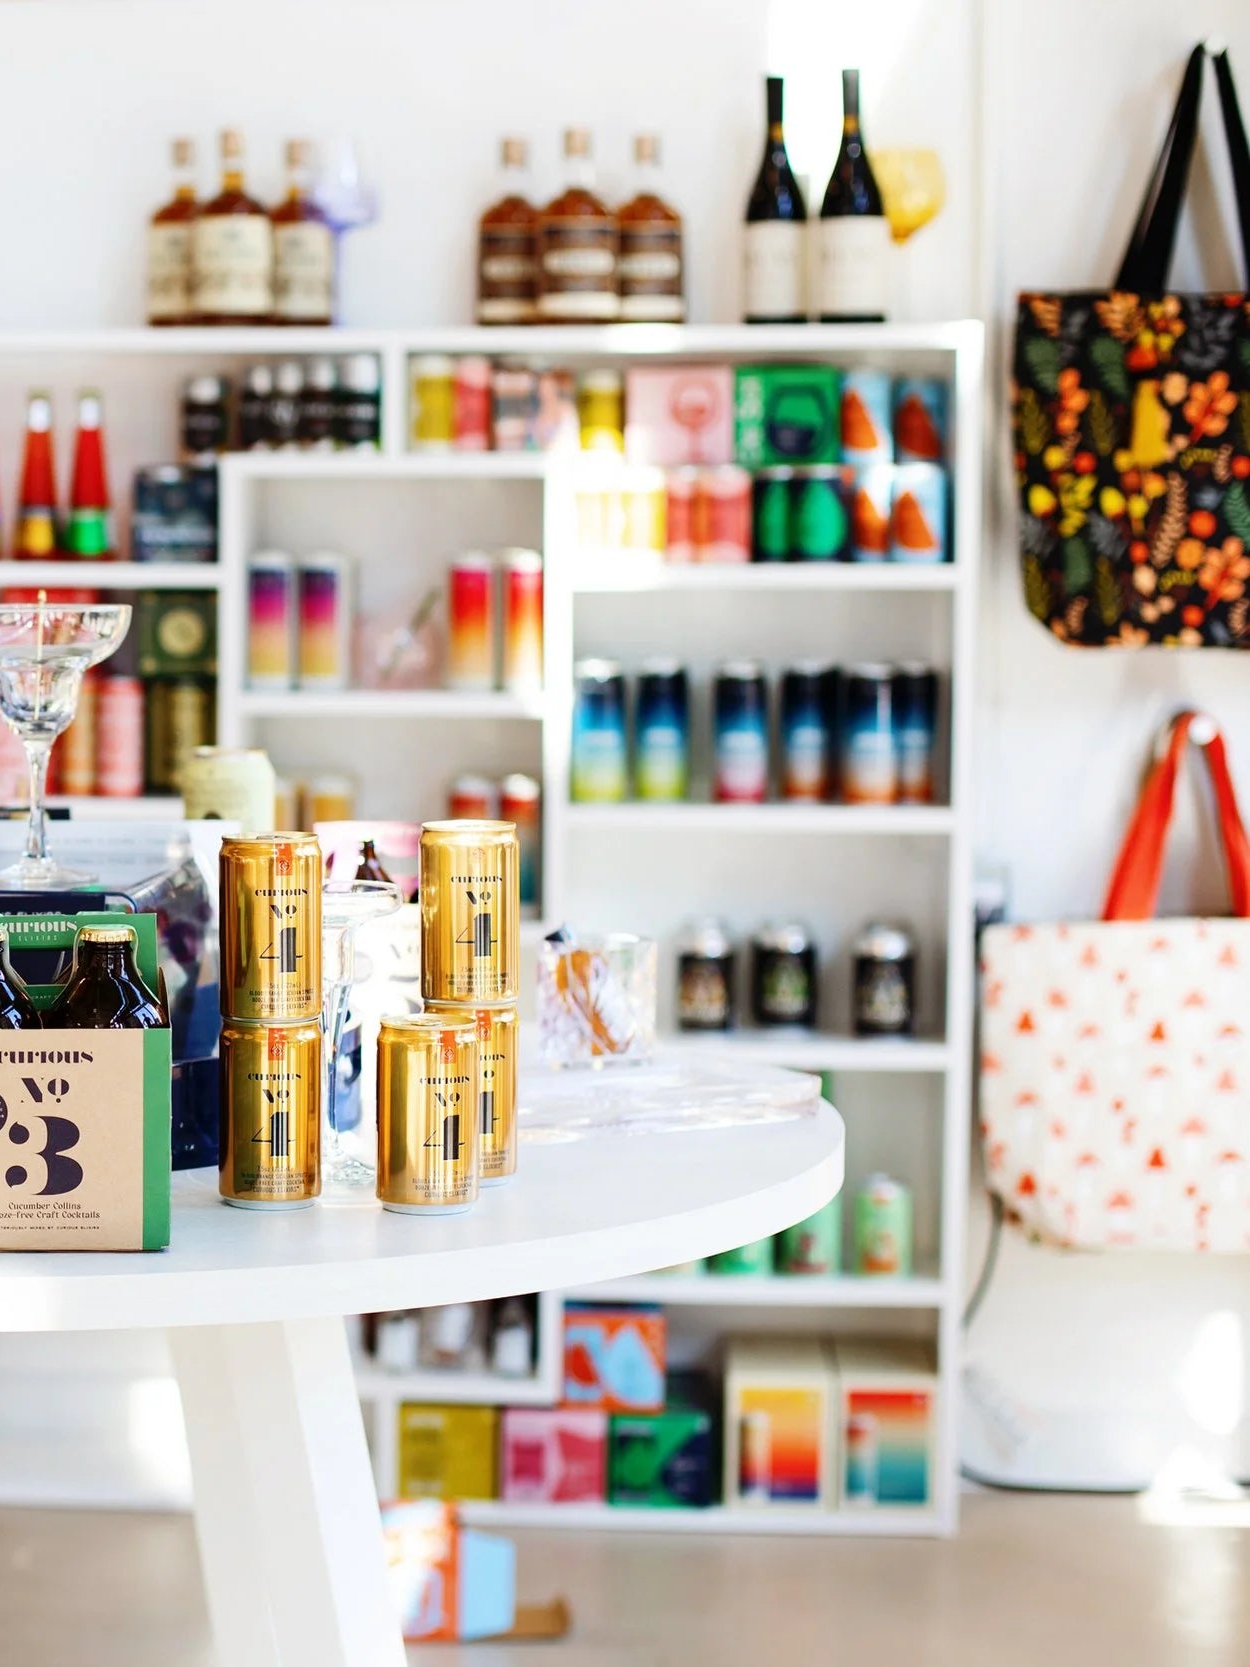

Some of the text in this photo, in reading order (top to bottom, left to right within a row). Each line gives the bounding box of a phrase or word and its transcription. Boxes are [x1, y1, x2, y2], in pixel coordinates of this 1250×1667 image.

[450, 875, 503, 884] curious
[254, 887, 308, 897] curious
[455, 913, 498, 957] 4
[259, 927, 303, 973] 4
[247, 1072, 302, 1081] curious
[419, 1076, 470, 1085] curious
[250, 1111, 296, 1157] 4
[423, 1114, 466, 1161] 4
[5, 1115, 84, 1196] 3
[8, 1201, 82, 1210] Cucumber Collins
[36, 1210, 59, 1219] Craft
[61, 1210, 100, 1219] Cocktails
